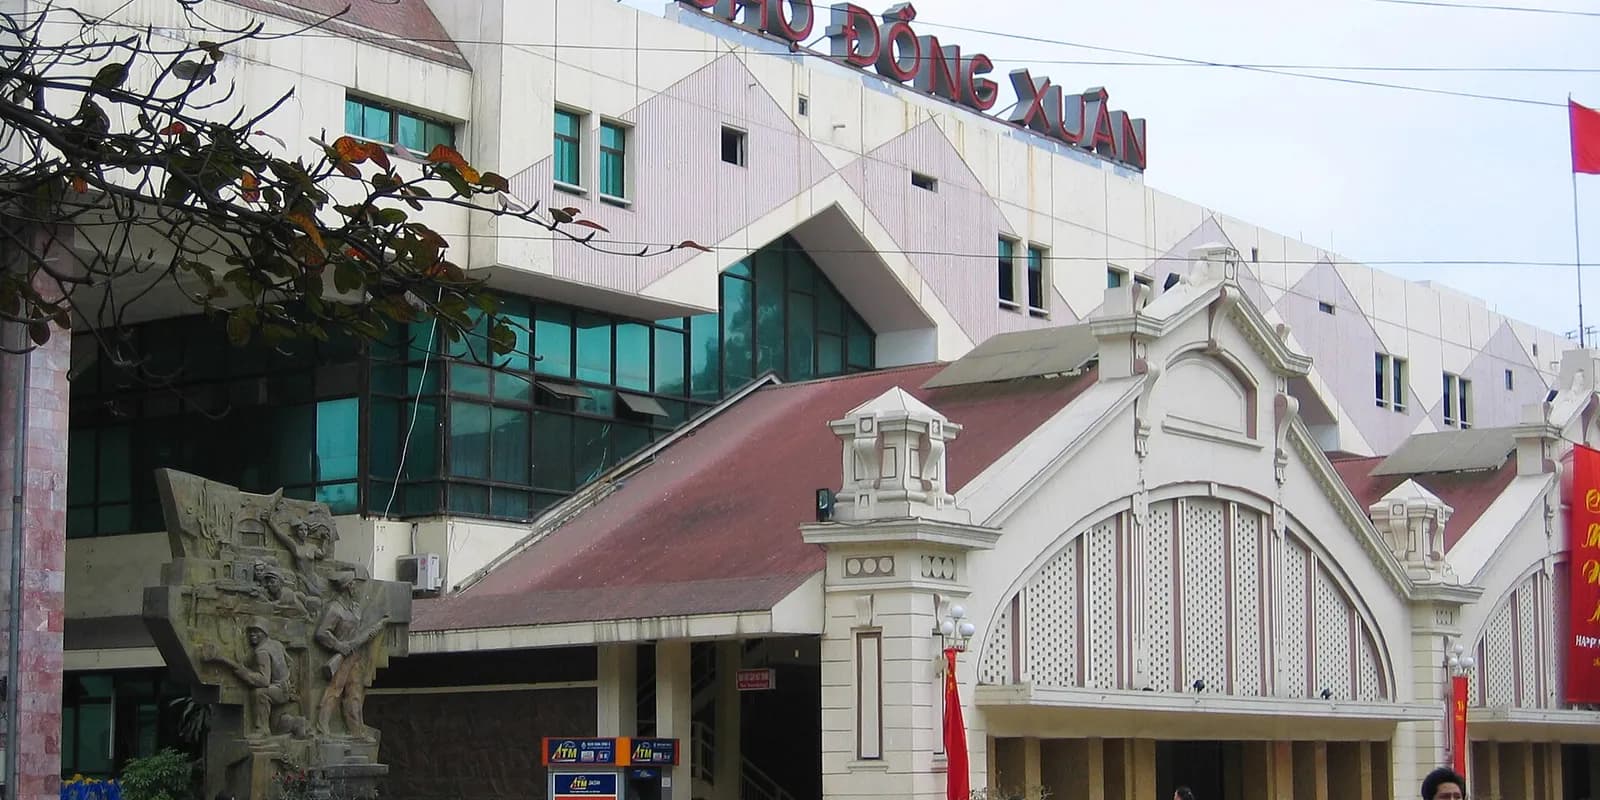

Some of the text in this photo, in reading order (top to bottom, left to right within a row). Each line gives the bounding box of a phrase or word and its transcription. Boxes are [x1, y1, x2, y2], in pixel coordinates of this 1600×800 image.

[1008, 68, 1146, 170] XUÂN
[552, 743, 577, 760] ATM
[632, 744, 652, 760] ATM
[570, 777, 587, 788] ATM
